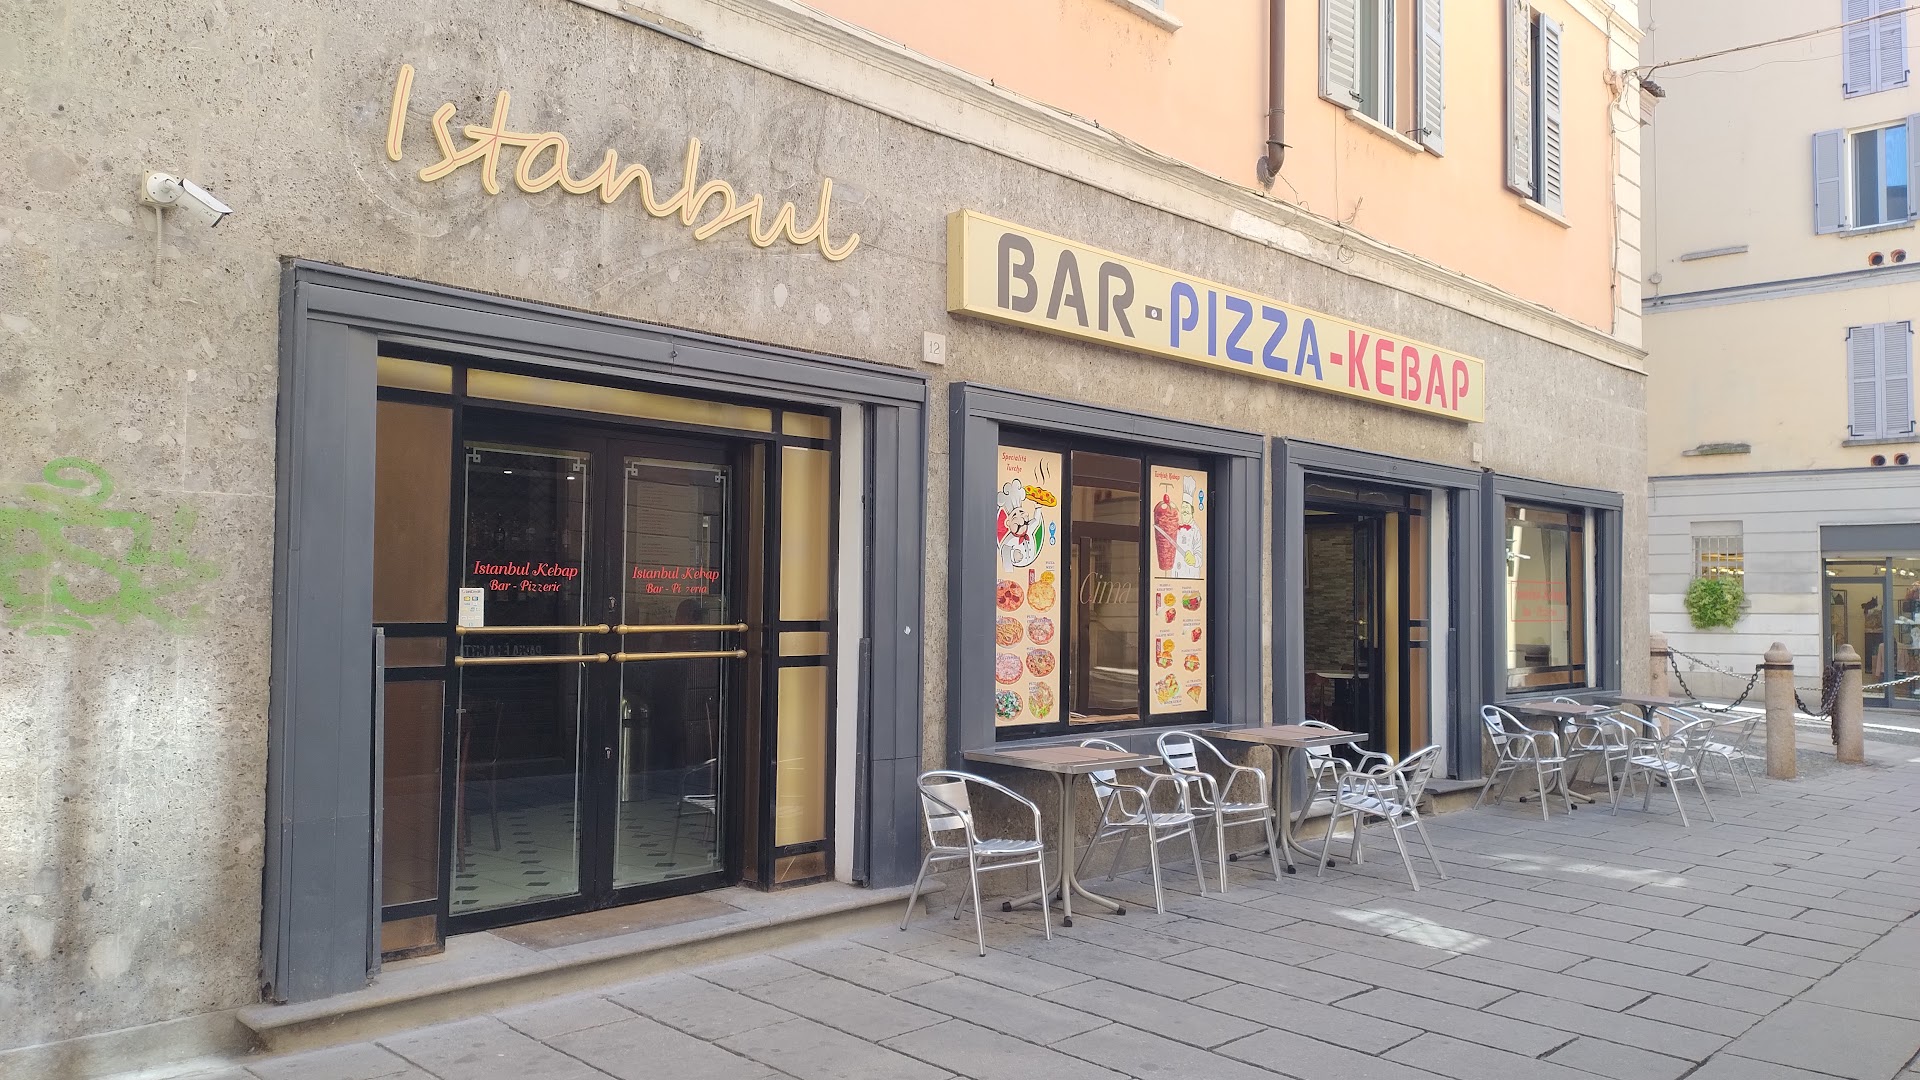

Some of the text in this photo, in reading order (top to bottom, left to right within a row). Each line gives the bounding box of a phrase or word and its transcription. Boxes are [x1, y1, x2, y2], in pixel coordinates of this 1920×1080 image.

[387, 64, 860, 263] Istanbul
[929, 341, 940, 355] 12
[473, 560, 578, 581] Istanbul Kebap
[632, 566, 679, 580] Istanbul
[489, 579, 511, 591] Bar
[645, 583, 664, 594] Bar
[1079, 571, 1132, 605] Cima
